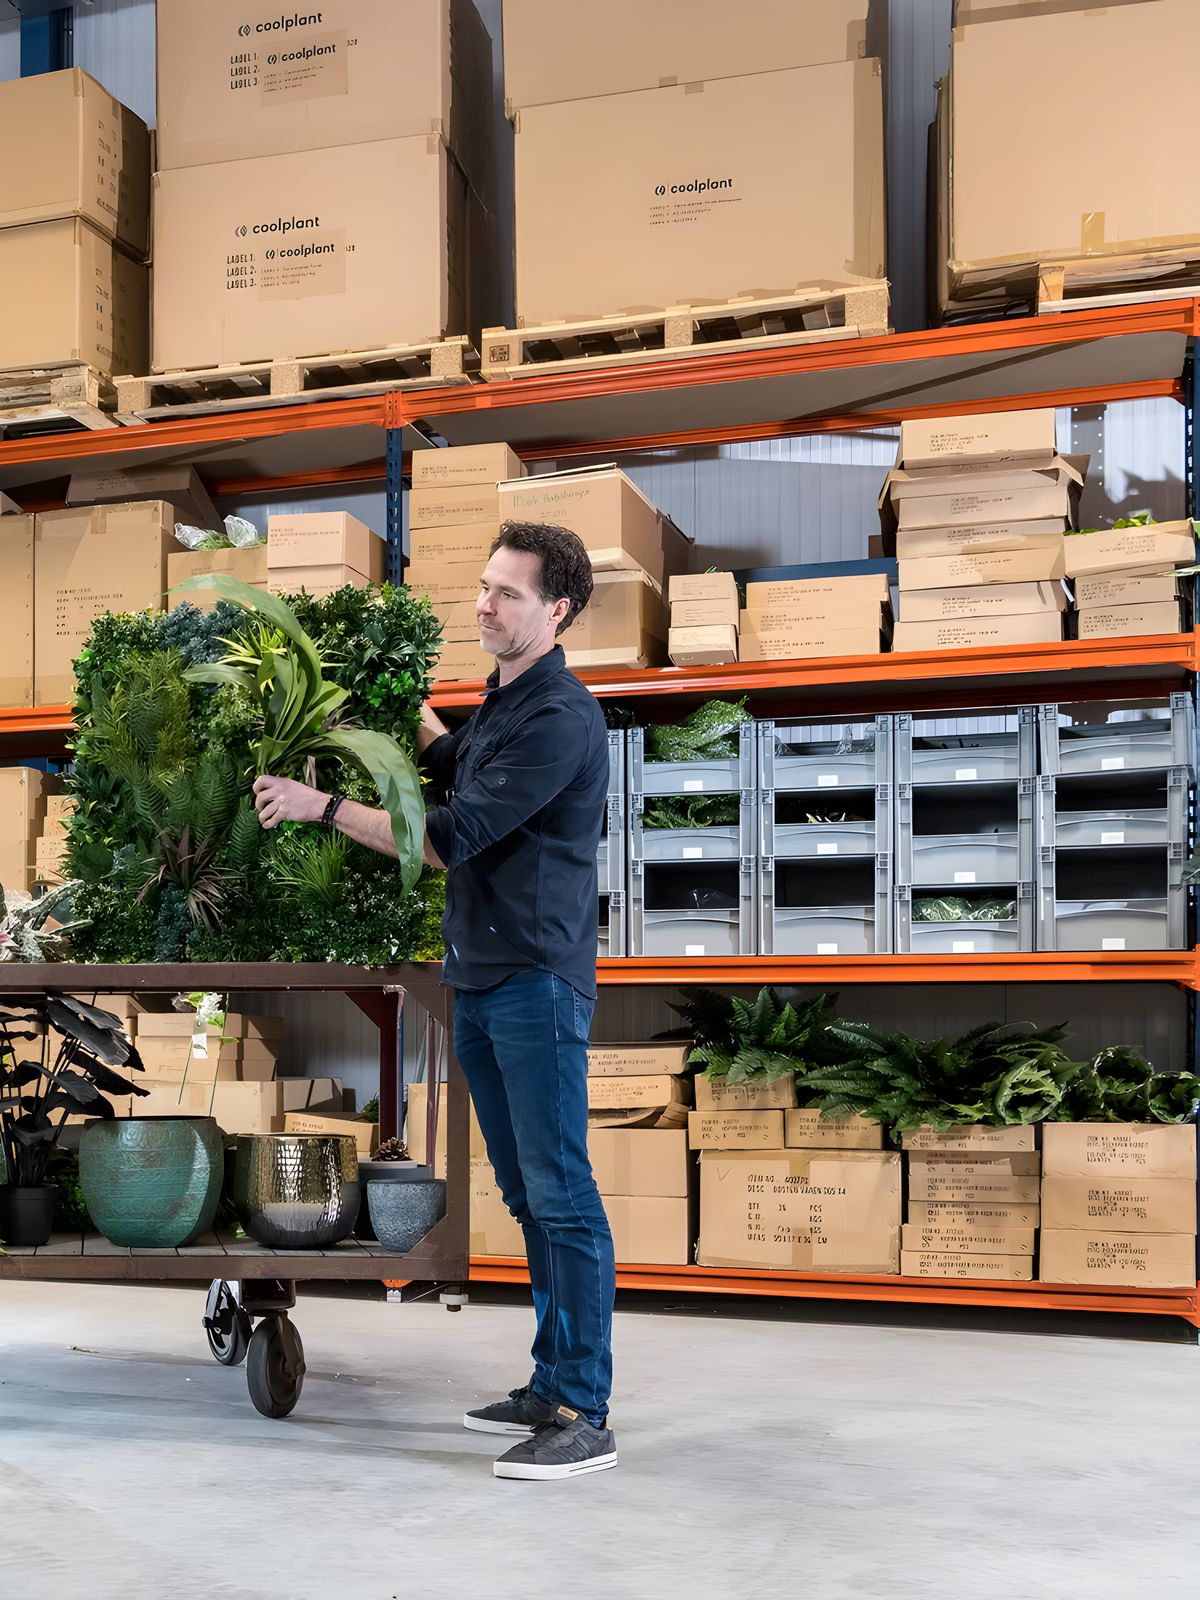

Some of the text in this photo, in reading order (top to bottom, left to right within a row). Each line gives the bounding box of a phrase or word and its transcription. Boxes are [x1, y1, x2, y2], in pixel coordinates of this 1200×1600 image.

[256, 12, 322, 32] coolplant
[281, 44, 336, 60] coolplant
[671, 178, 732, 193] coolplant
[253, 217, 320, 234] coolplant
[280, 243, 335, 257] coolplant
